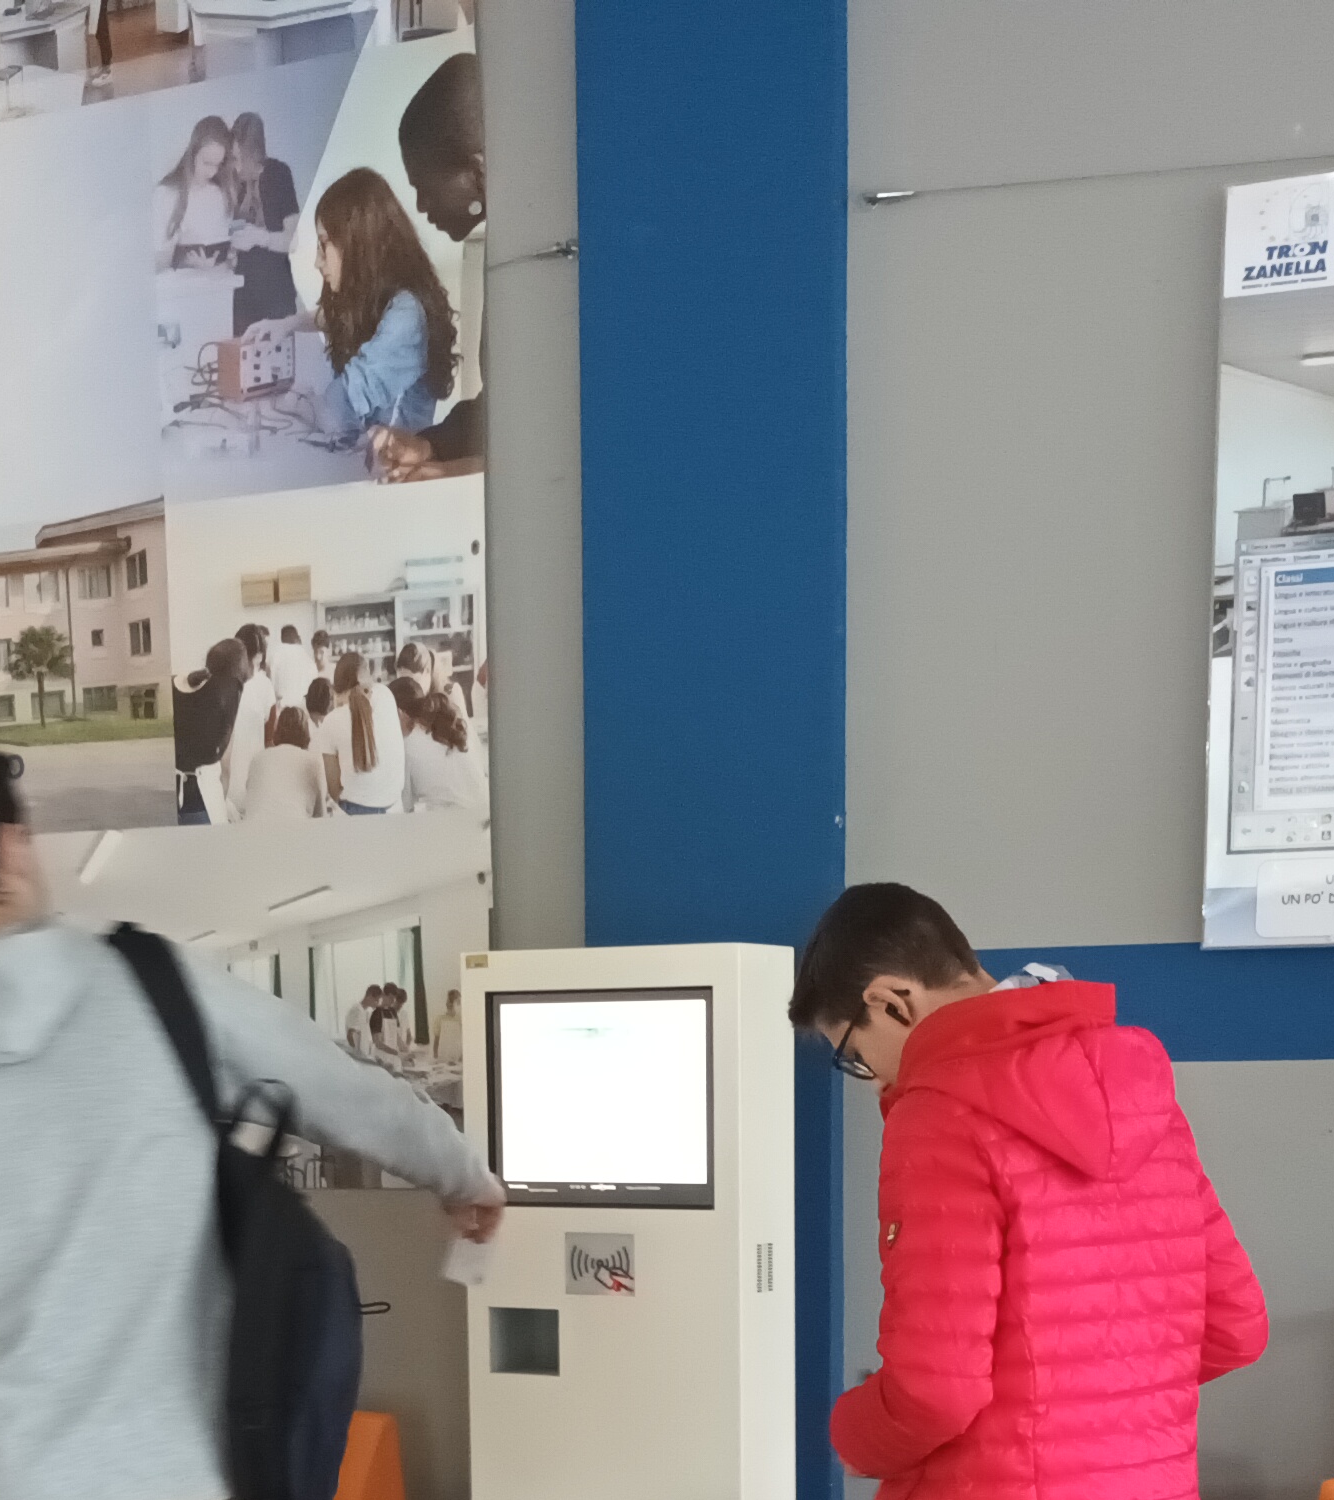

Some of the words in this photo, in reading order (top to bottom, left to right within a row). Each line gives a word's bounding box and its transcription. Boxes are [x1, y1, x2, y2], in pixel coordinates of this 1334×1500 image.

[1265, 240, 1328, 260] TRON
[1243, 258, 1327, 281] ZANELLA
[1282, 894, 1300, 904] UN
[1305, 891, 1324, 904] PO'
